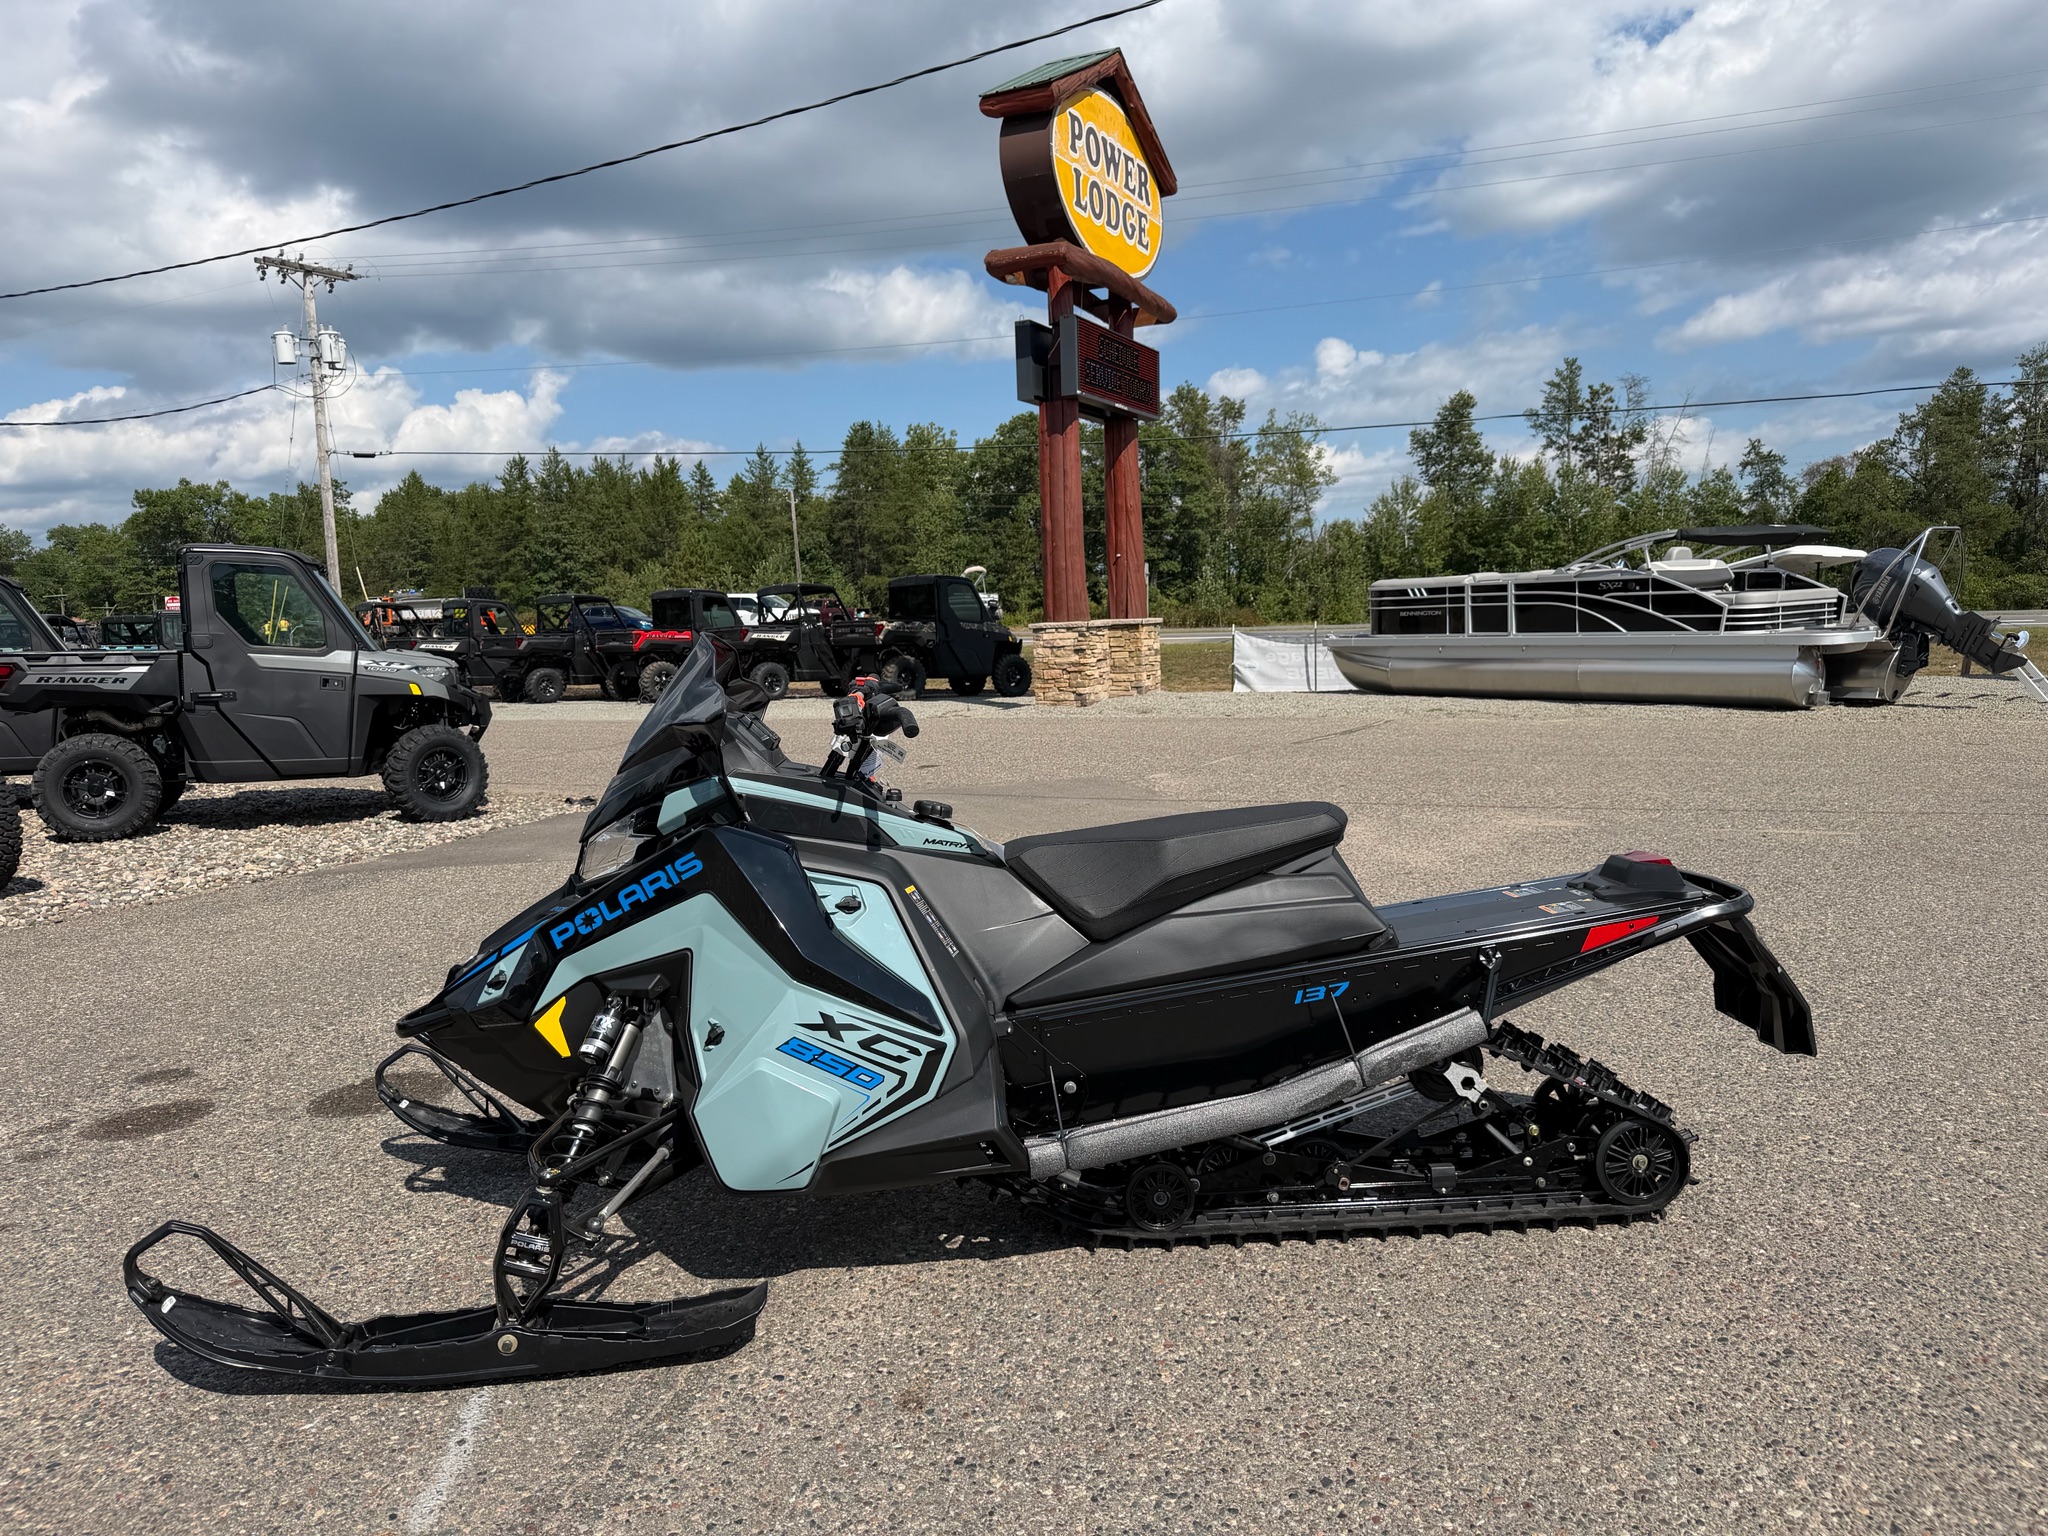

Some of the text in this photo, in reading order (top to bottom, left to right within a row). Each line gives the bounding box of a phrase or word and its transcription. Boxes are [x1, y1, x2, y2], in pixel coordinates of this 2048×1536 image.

[1067, 110, 1152, 208] POWER
[1072, 167, 1150, 252] LODGE
[1598, 581, 1623, 590] SX22
[1876, 575, 1893, 599] YAMAHA
[366, 659, 406, 668] XP
[35, 676, 128, 684] RANGER
[922, 838, 974, 851] MATRYX
[549, 851, 703, 950] POLARIS
[1294, 981, 1350, 1005] 137
[794, 1011, 922, 1063] XC
[775, 1036, 885, 1091] 850
[510, 1239, 551, 1253] POLARIS
